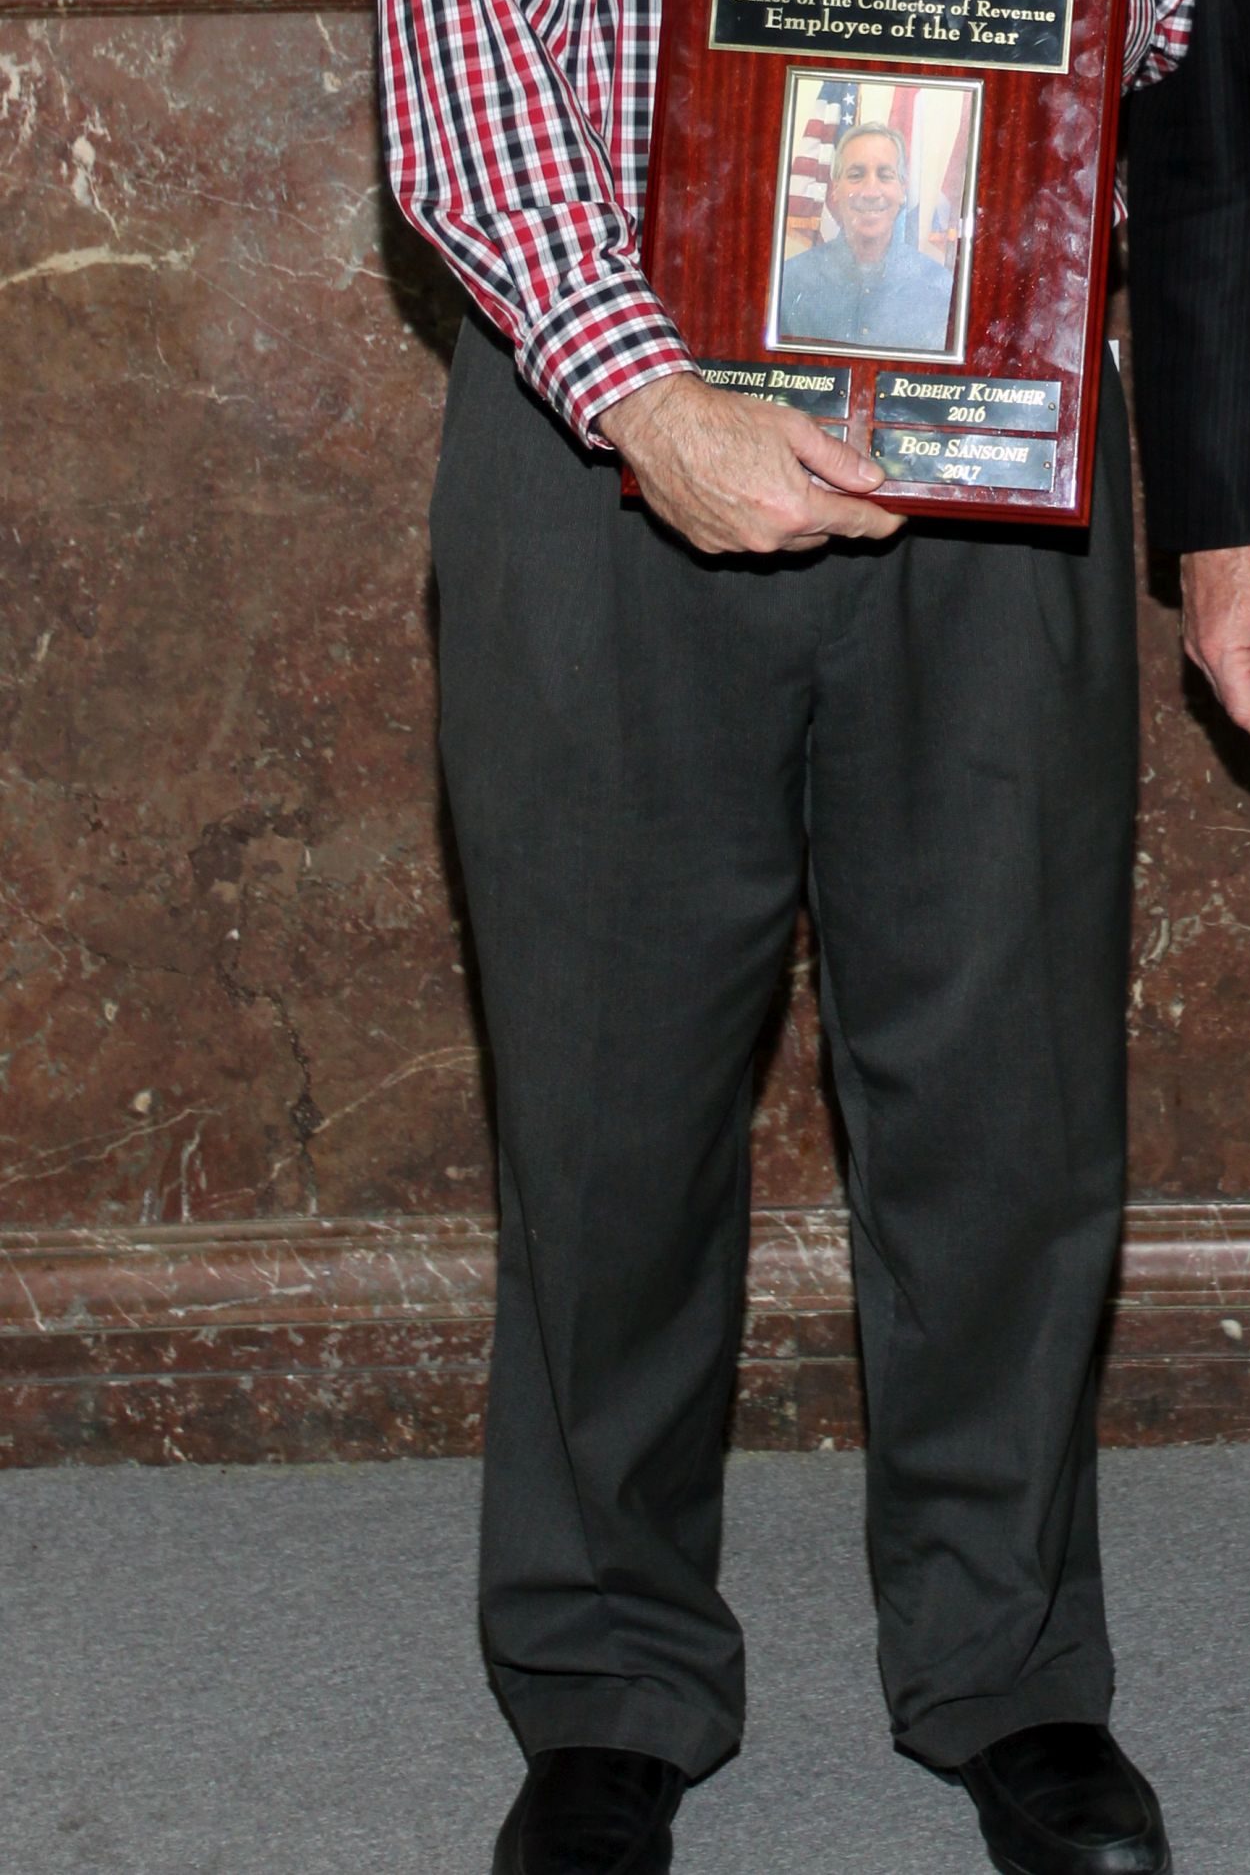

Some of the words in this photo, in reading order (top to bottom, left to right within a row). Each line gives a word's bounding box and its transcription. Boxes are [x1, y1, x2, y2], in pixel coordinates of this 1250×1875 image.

[976, 0, 1056, 23] Revenue
[765, 7, 883, 39] Employee
[891, 14, 917, 38] of
[923, 16, 961, 41] the
[968, 21, 1020, 45] Year
[947, 406, 986, 423] 2016
[941, 463, 982, 481] 2017
